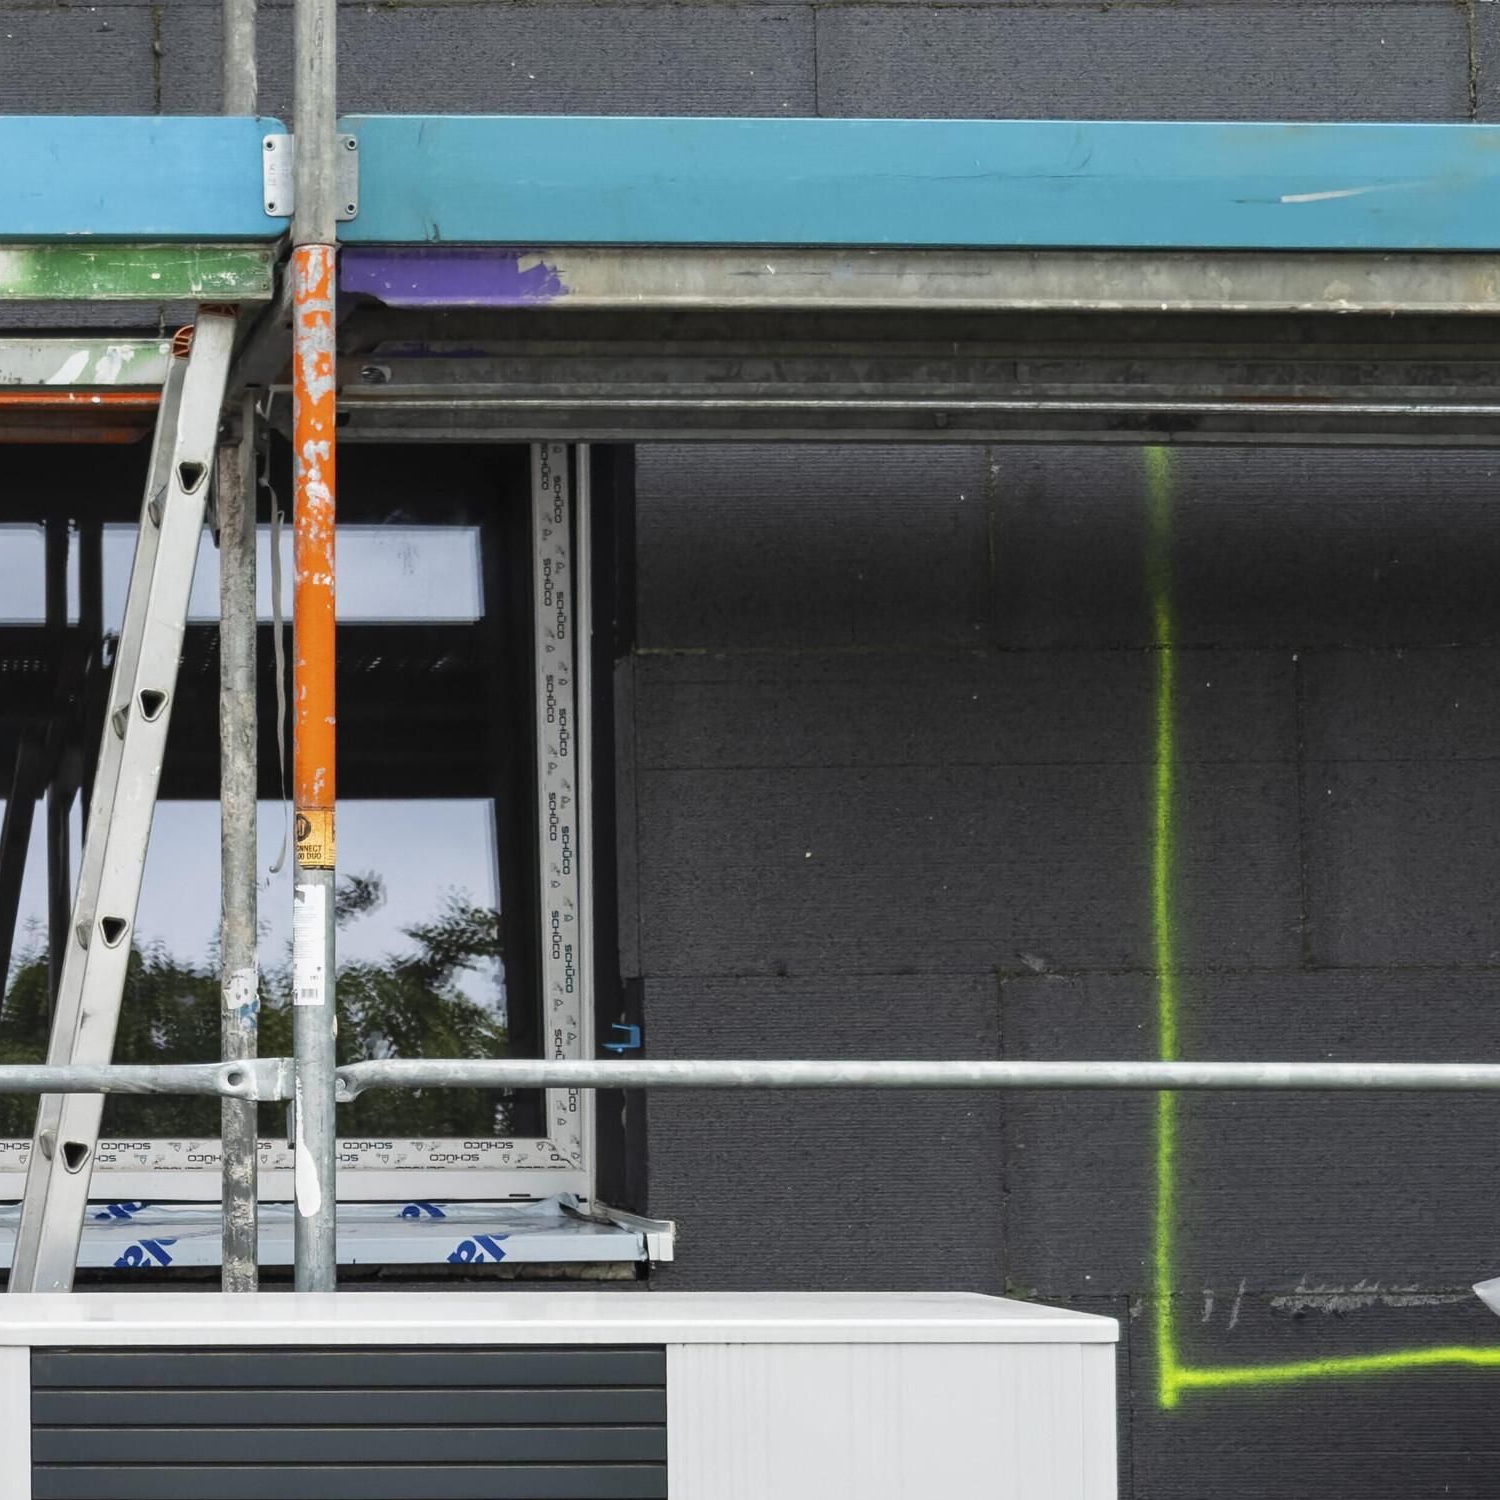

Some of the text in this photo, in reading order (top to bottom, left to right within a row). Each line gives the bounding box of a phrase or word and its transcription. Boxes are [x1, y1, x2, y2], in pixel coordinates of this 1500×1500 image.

[306, 852, 322, 860] DUO
[554, 1028, 565, 1060] SCHÜ
[188, 1154, 222, 1164] HÜCO
